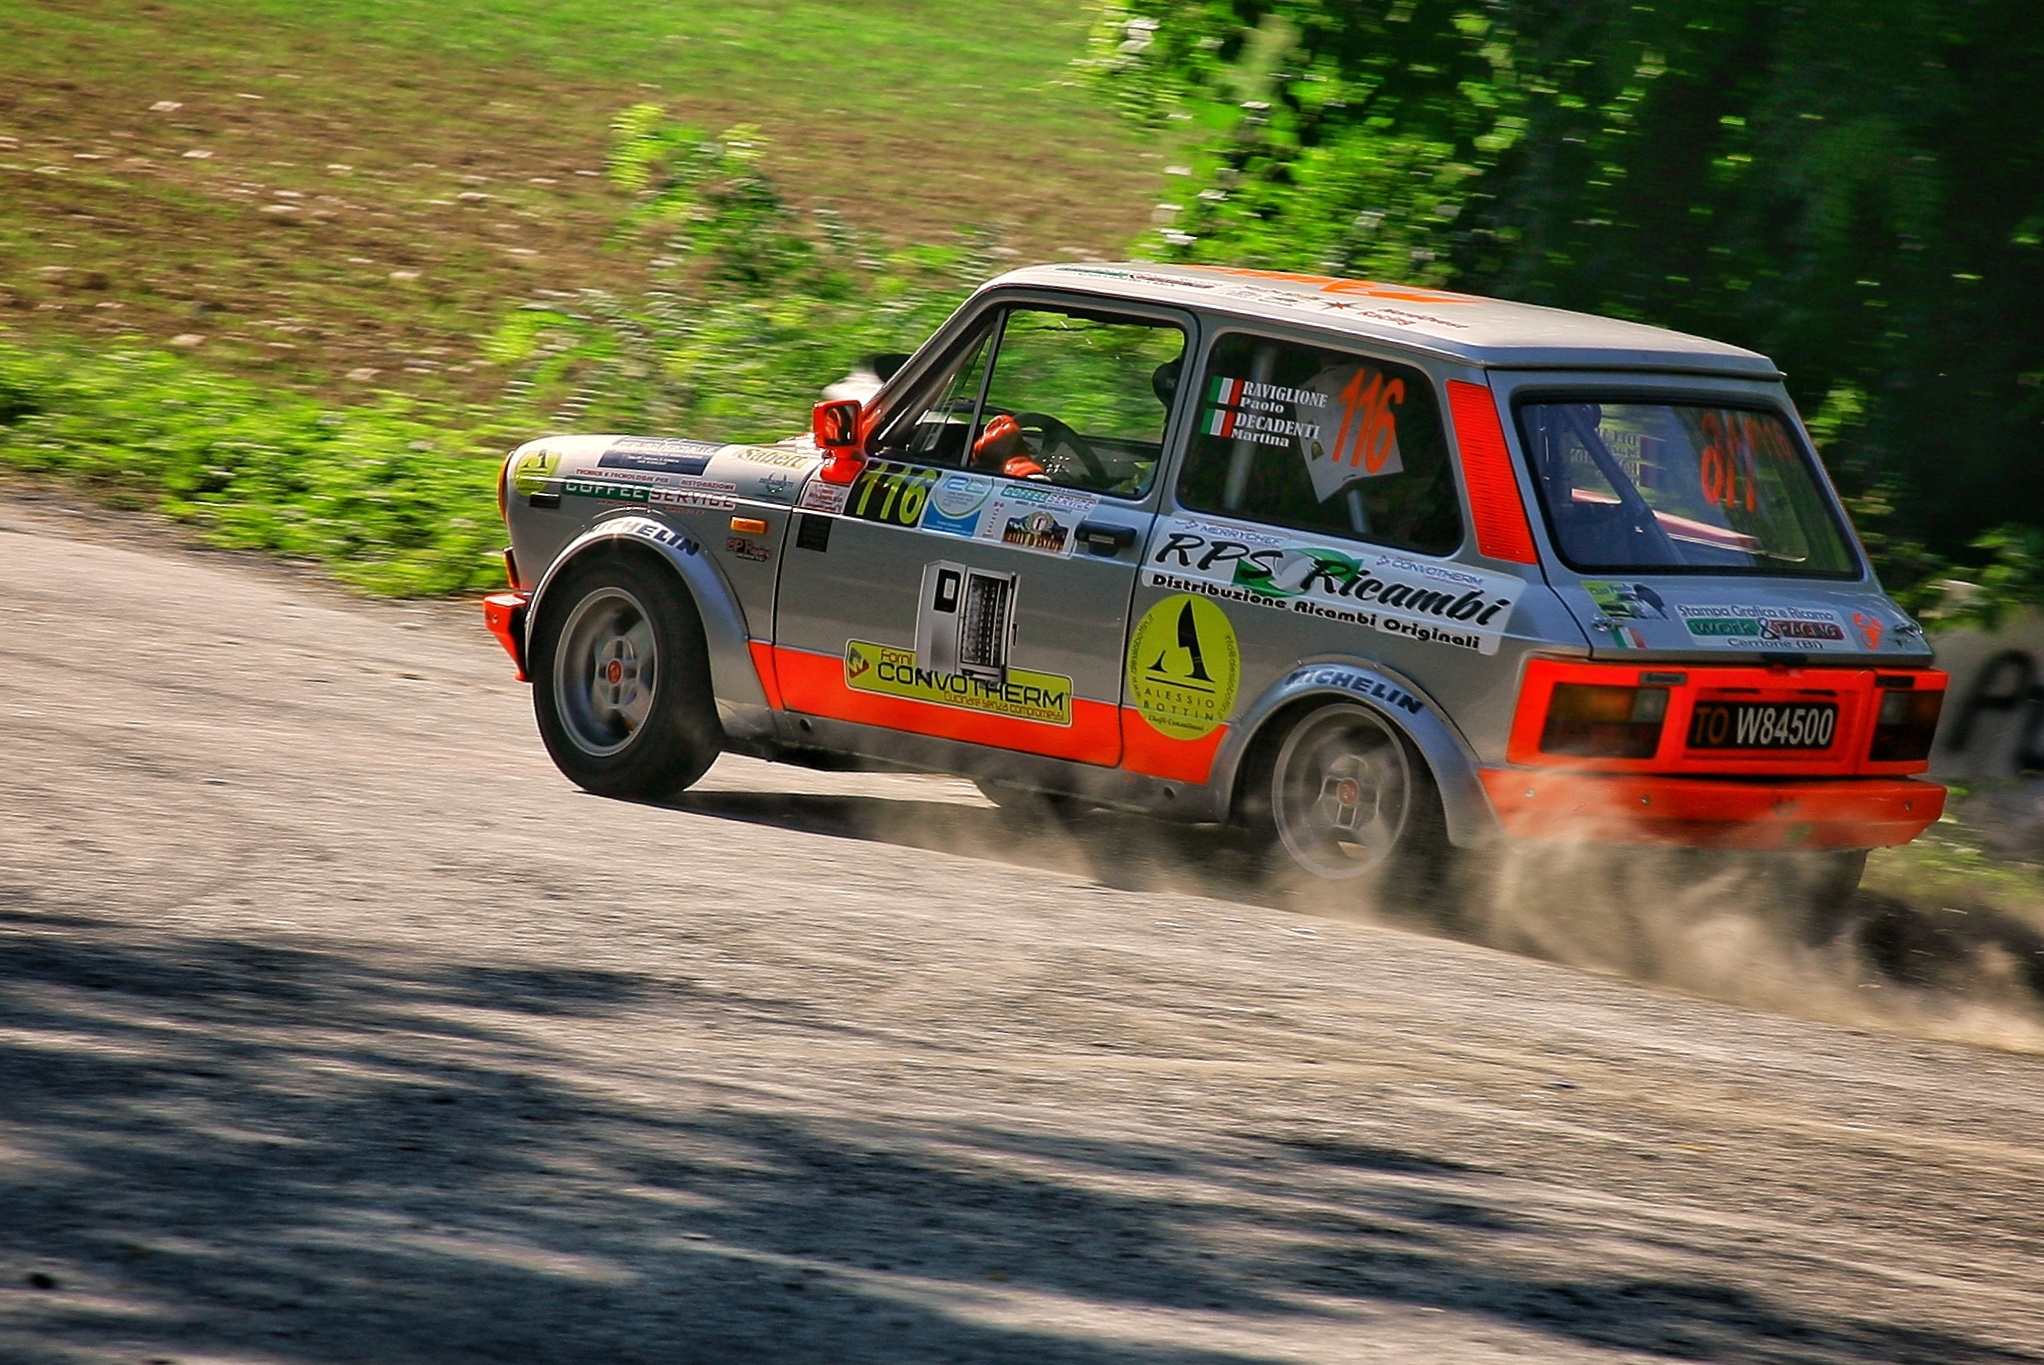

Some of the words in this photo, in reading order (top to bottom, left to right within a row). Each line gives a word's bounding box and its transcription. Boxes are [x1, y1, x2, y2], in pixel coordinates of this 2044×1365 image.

[1239, 397, 1285, 414] Paolo
[1242, 380, 1329, 408] RAVIGLIONE
[1233, 412, 1321, 440] DECADENTI
[1331, 367, 1406, 474] 116
[1231, 428, 1290, 448] Martina
[855, 461, 938, 525] 116
[1003, 486, 1049, 503] COFFEE
[1046, 493, 1096, 510] SERVICE
[1200, 525, 1284, 545] MERRYCHEF
[1154, 533, 1284, 579] RPS
[1300, 559, 1511, 626] Ricambi
[1391, 559, 1485, 585] CONVOTHERM
[1152, 573, 1288, 609] Distribuzione
[1293, 601, 1376, 627] Ricambi
[1383, 618, 1480, 649] Originali
[1676, 604, 1731, 617] Stampa
[1731, 605, 1778, 618] Grafica
[1778, 608, 1788, 618] e
[1790, 607, 1834, 620] Ricamo
[1726, 637, 1792, 649] Cerrione
[880, 649, 913, 666] Forni
[877, 663, 1065, 712] CONVOTHERM
[1144, 687, 1215, 708] ALESSIO
[1286, 667, 1425, 715] MICHELIN
[943, 690, 981, 706] Cucinare
[981, 698, 1009, 712] senza
[1009, 703, 1065, 721] compromessi
[1143, 700, 1215, 721] BOTTIN
[1694, 706, 1730, 746] TO
[1735, 706, 1836, 747] W84500
